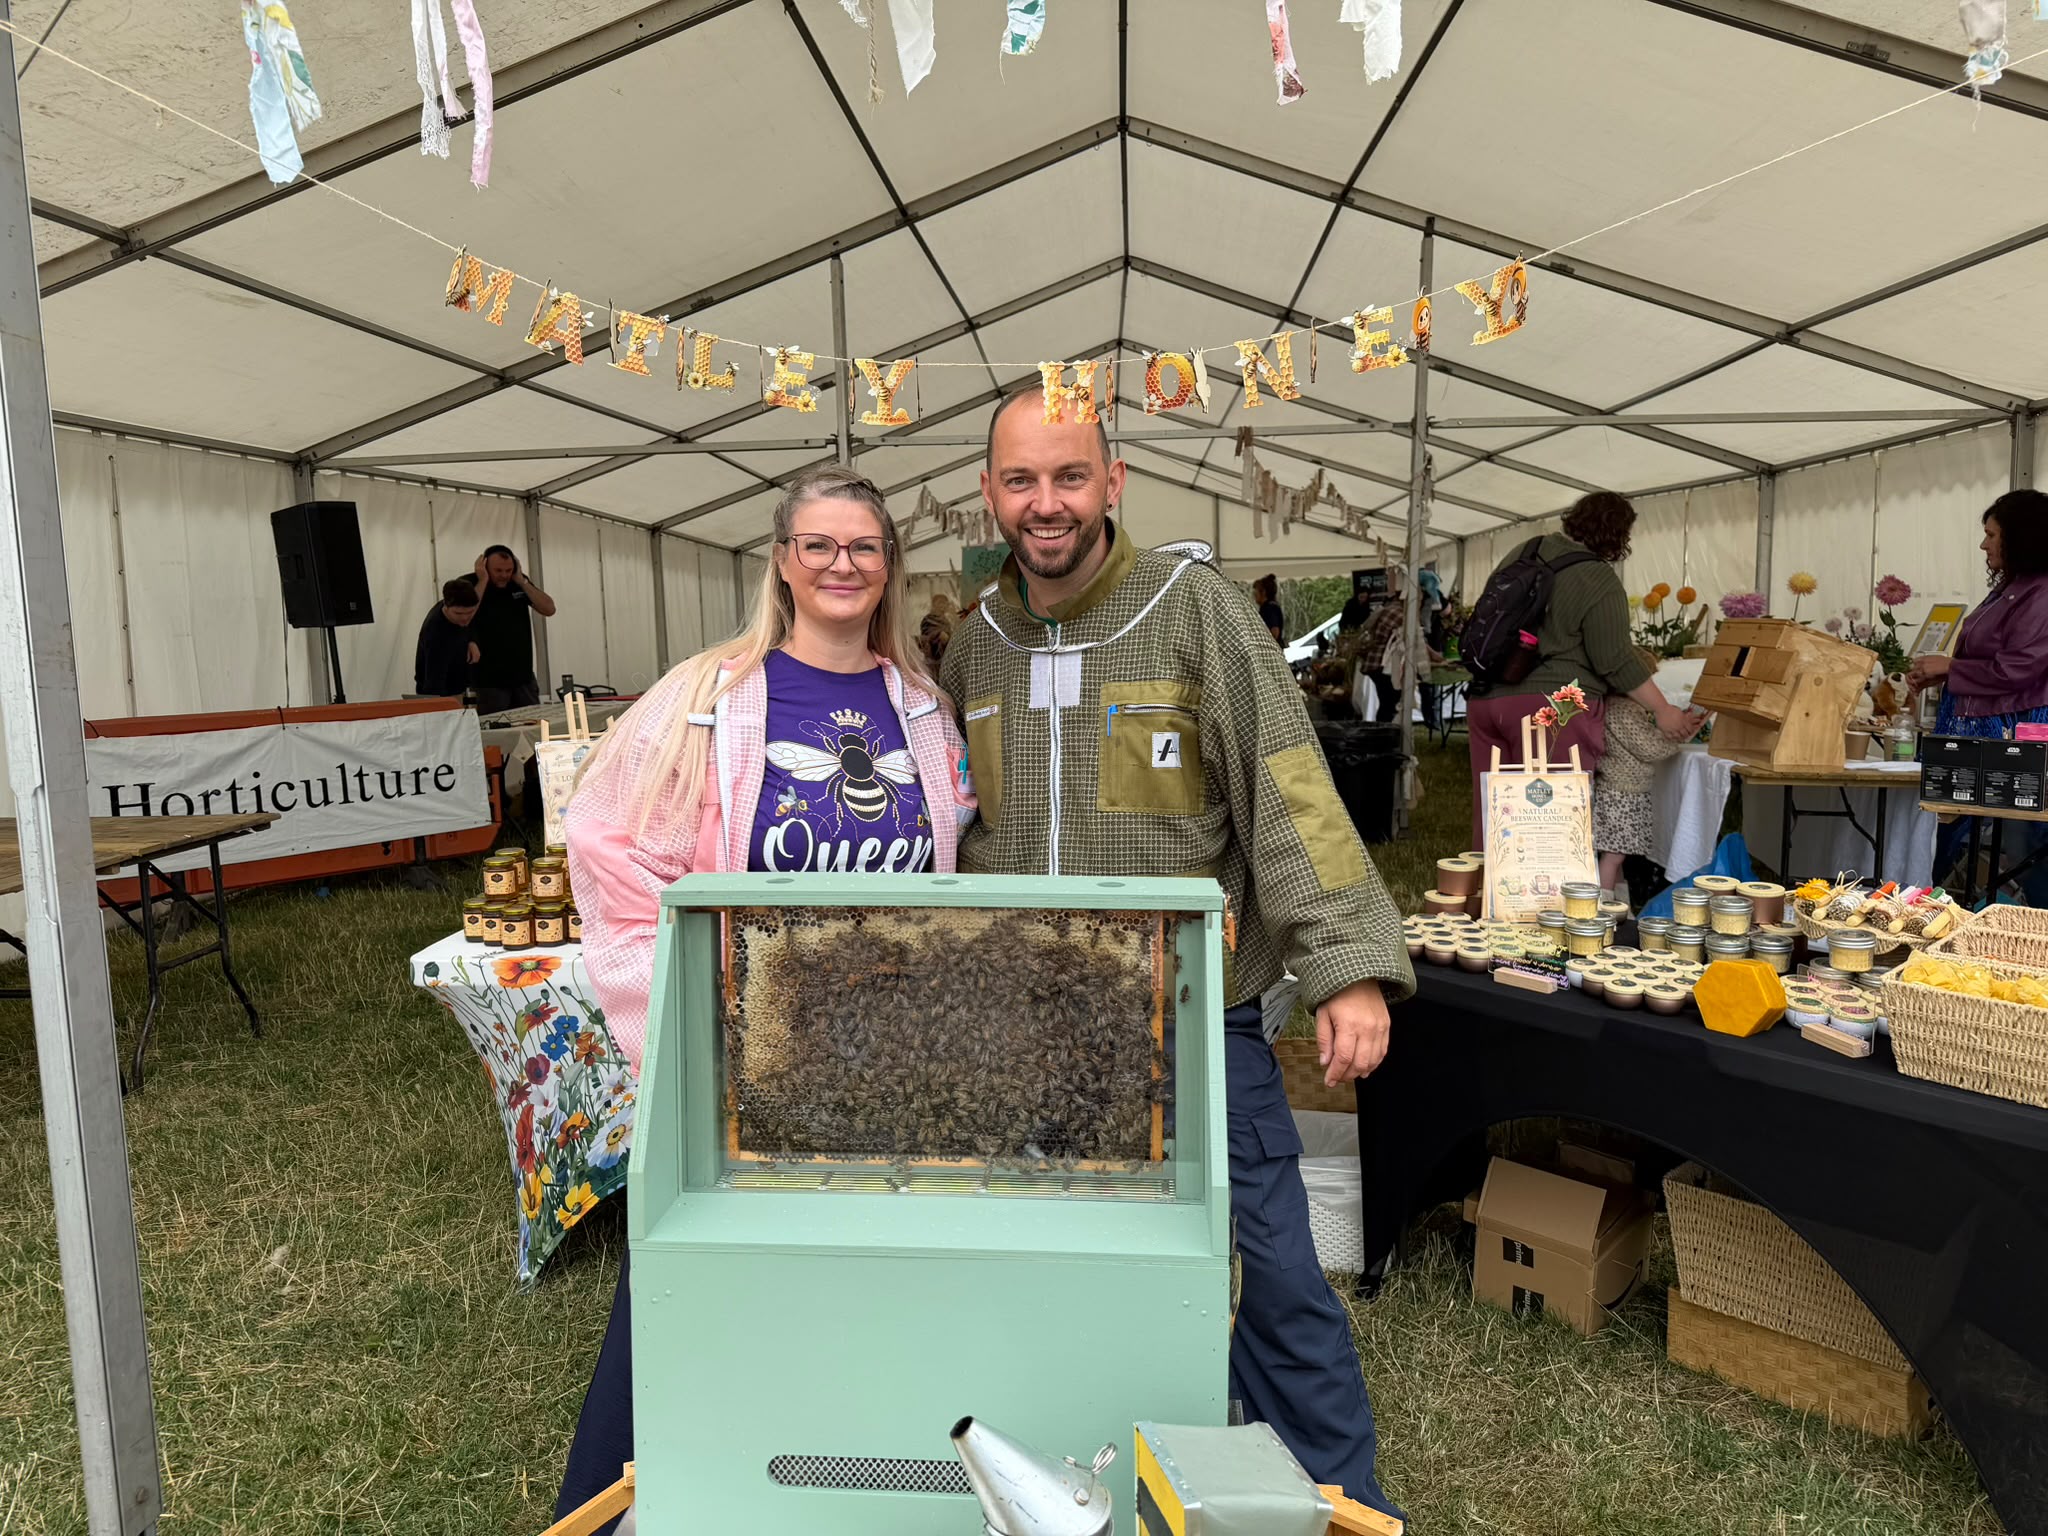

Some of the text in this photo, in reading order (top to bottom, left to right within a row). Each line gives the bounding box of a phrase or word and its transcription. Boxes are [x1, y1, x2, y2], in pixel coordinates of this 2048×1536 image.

[455, 254, 1528, 427] MATLEY HONEY
[102, 762, 457, 816] Horticulture
[763, 817, 932, 873] Queen
